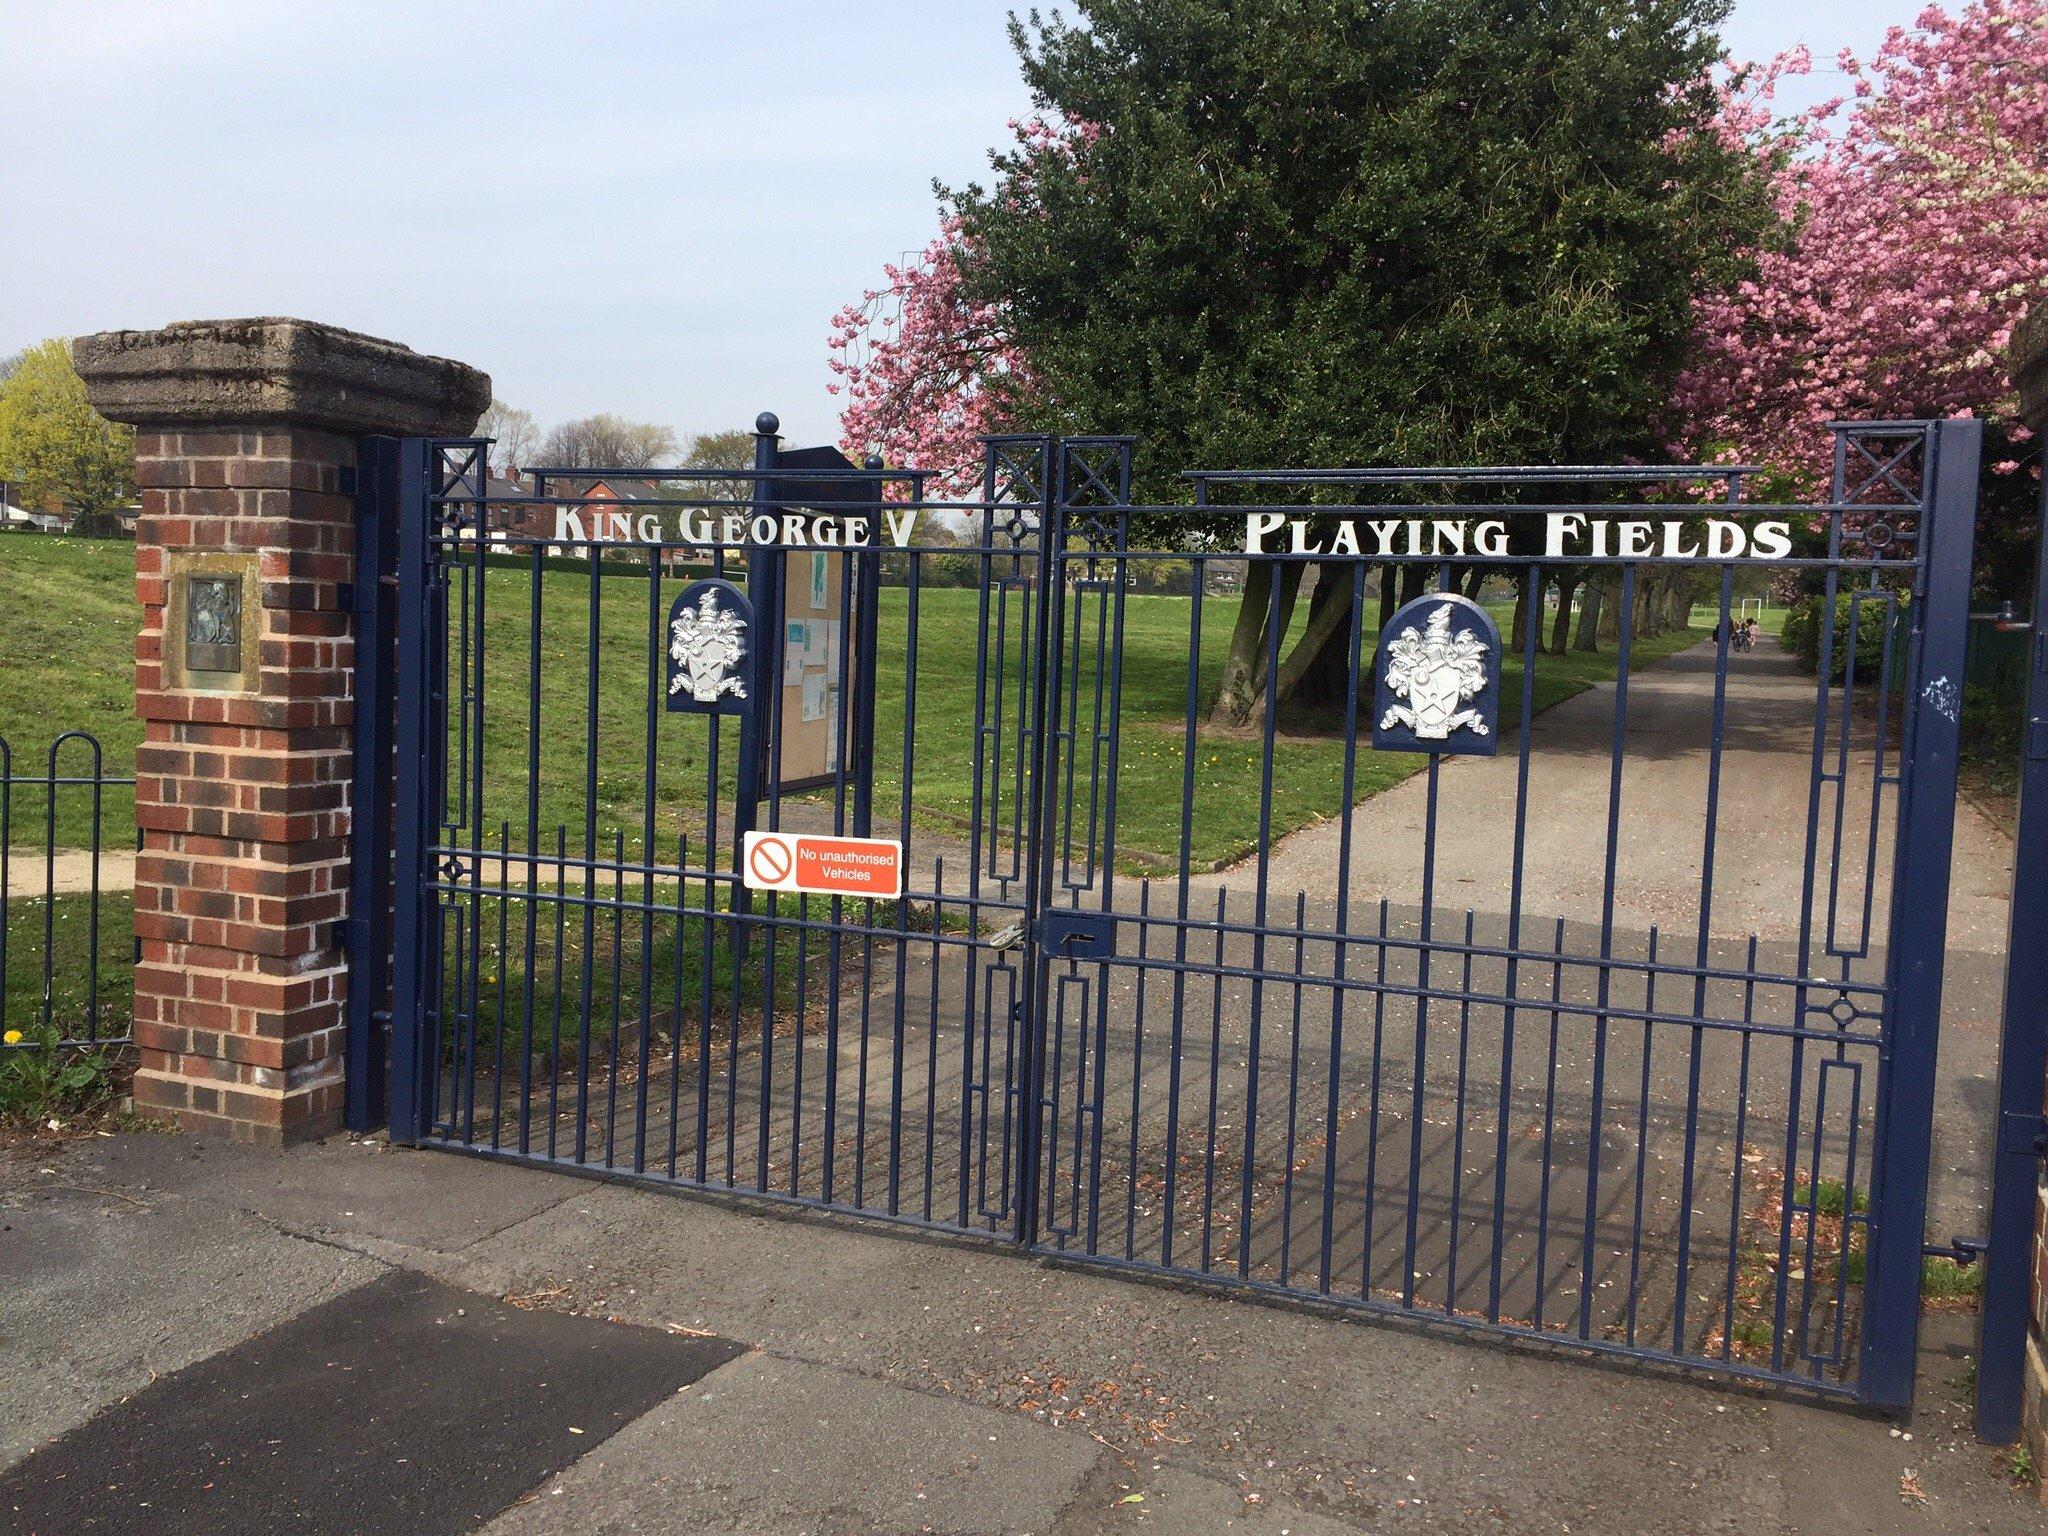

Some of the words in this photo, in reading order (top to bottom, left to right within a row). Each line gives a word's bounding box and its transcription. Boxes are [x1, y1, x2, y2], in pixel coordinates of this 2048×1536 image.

[554, 504, 662, 543] KING
[679, 506, 870, 547] GEORGE
[885, 509, 918, 547] V
[1245, 512, 1510, 556] PLAYING
[1545, 512, 1792, 558] FIELDS
[800, 848, 816, 860] No
[820, 851, 894, 866] unauthorised
[822, 865, 871, 881] Vehicles
